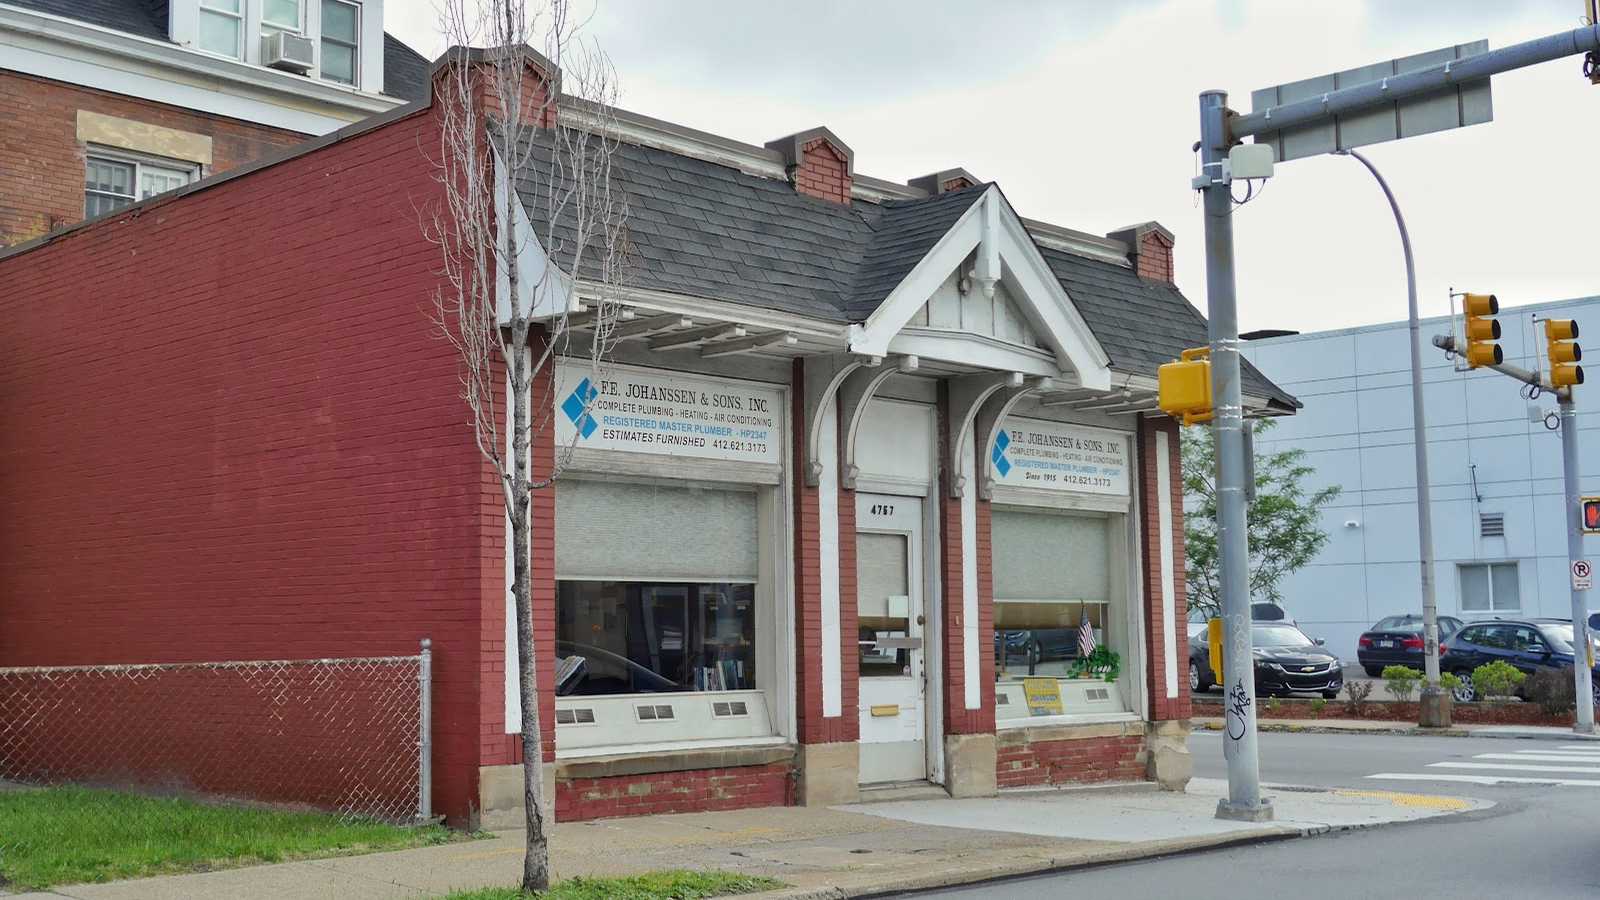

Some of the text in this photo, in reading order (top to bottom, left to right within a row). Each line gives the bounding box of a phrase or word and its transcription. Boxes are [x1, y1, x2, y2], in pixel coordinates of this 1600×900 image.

[625, 383, 697, 405] JOHANSSEN
[700, 392, 709, 406] &
[748, 397, 769, 413] INC.
[597, 400, 636, 413] COMPLETE
[638, 404, 674, 417] PLUMBING
[680, 409, 708, 421] HEATING
[714, 412, 725, 423] AIR
[726, 414, 772, 428] CONDITIONING
[603, 415, 657, 429] REGISTERED
[659, 420, 693, 433] MASTER
[694, 424, 732, 437] PLUMBER
[602, 429, 767, 453] ESTIMATES FURNISHED 412.621.3173
[1028, 432, 1073, 449] JOHANSSEN
[1075, 438, 1081, 450] &
[1043, 473, 1057, 482] 1915
[1063, 475, 1111, 487] 412.621.3173
